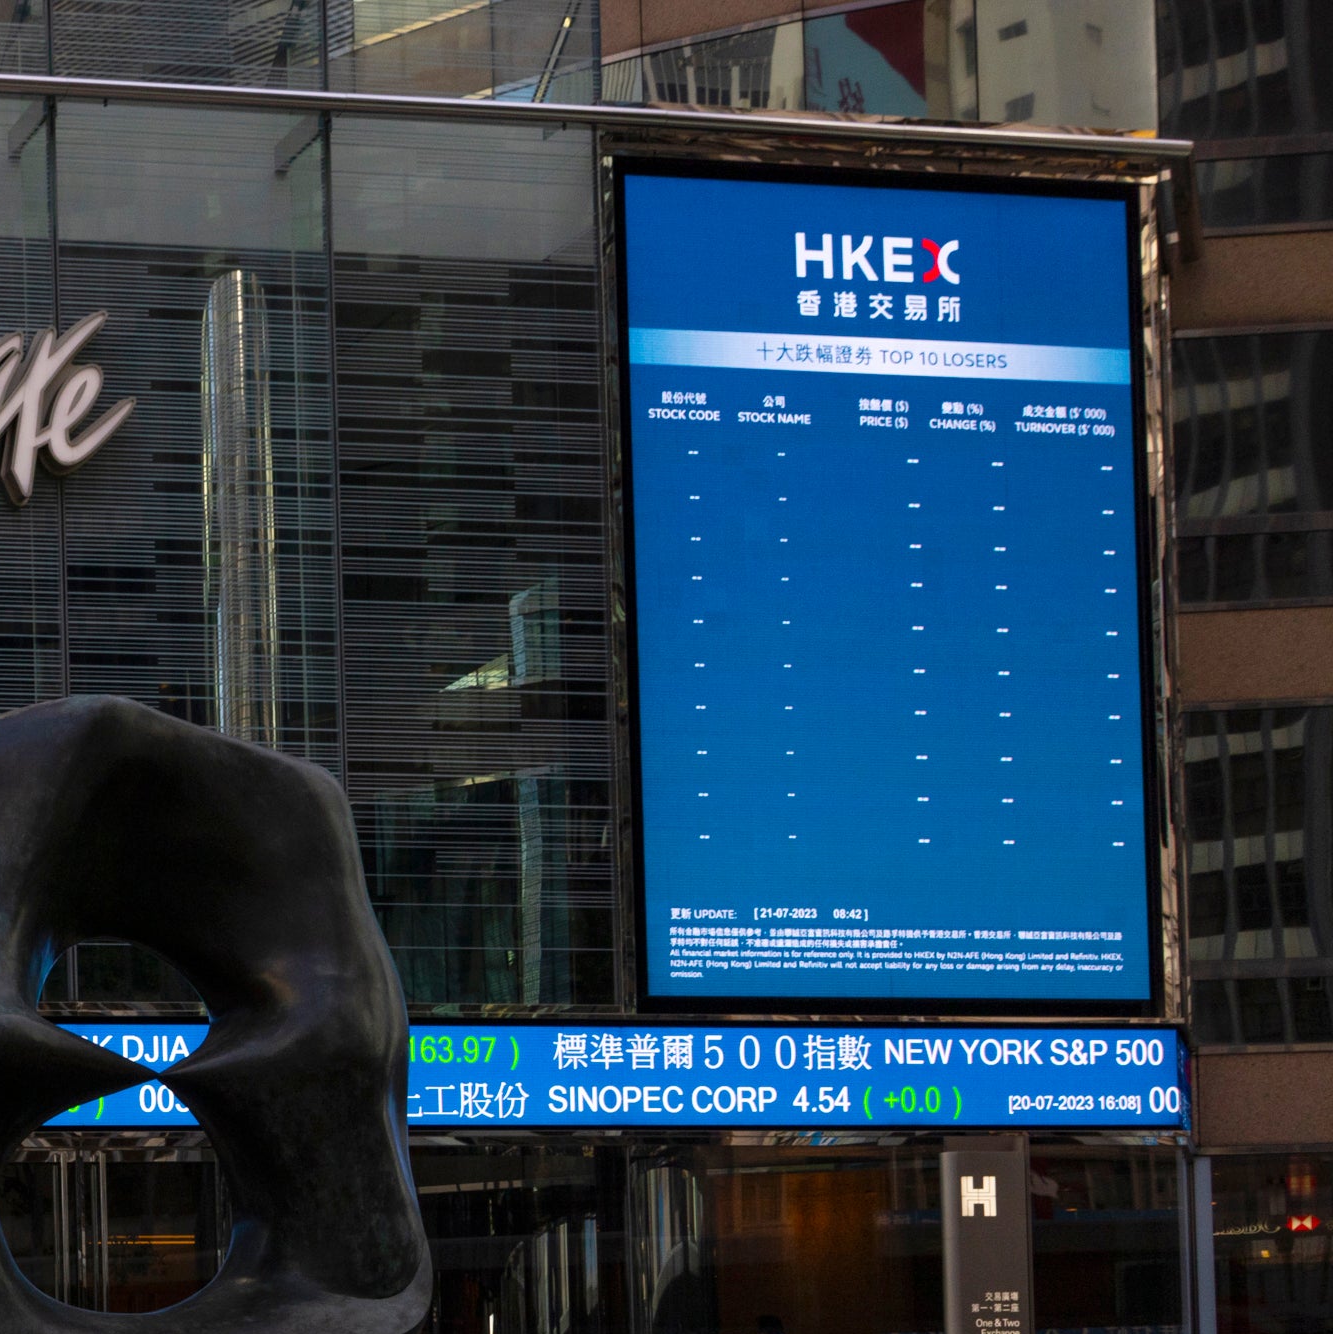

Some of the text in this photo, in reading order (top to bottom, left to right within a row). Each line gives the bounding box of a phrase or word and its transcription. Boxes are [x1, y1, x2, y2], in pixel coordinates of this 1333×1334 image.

[796, 232, 959, 284] HKEX
[797, 290, 960, 322] 香港交易所
[880, 350, 913, 364] TOP
[920, 352, 938, 365] 10
[944, 353, 1008, 368] LOSERS
[763, 396, 785, 408] 公司
[896, 400, 909, 412] ($)
[649, 408, 720, 421] STOCK CODE
[967, 404, 983, 415] (%)
[1085, 408, 1106, 420] 000)
[738, 412, 811, 424] STOCK NAME
[860, 416, 908, 429] PRICE ($)
[930, 419, 996, 432] CHANGE (%)
[1015, 422, 1076, 433] TURNOVER
[1093, 425, 1115, 436] 000)
[671, 908, 691, 919] 更新
[694, 909, 736, 919] UPDATE:
[122, 1035, 190, 1063] DJIA
[885, 1039, 952, 1064] NEW
[959, 1039, 1043, 1065] YORK
[1051, 1039, 1108, 1065] S&P
[1116, 1039, 1163, 1065] 500
[549, 1086, 683, 1113] SINOPEC
[692, 1086, 777, 1113] CORP
[793, 1086, 851, 1113] 4.54
[1009, 1095, 1094, 1114] [20-07-2023
[1099, 1095, 1141, 1114] 16:08]
[975, 1318, 1020, 1327] One & Two
